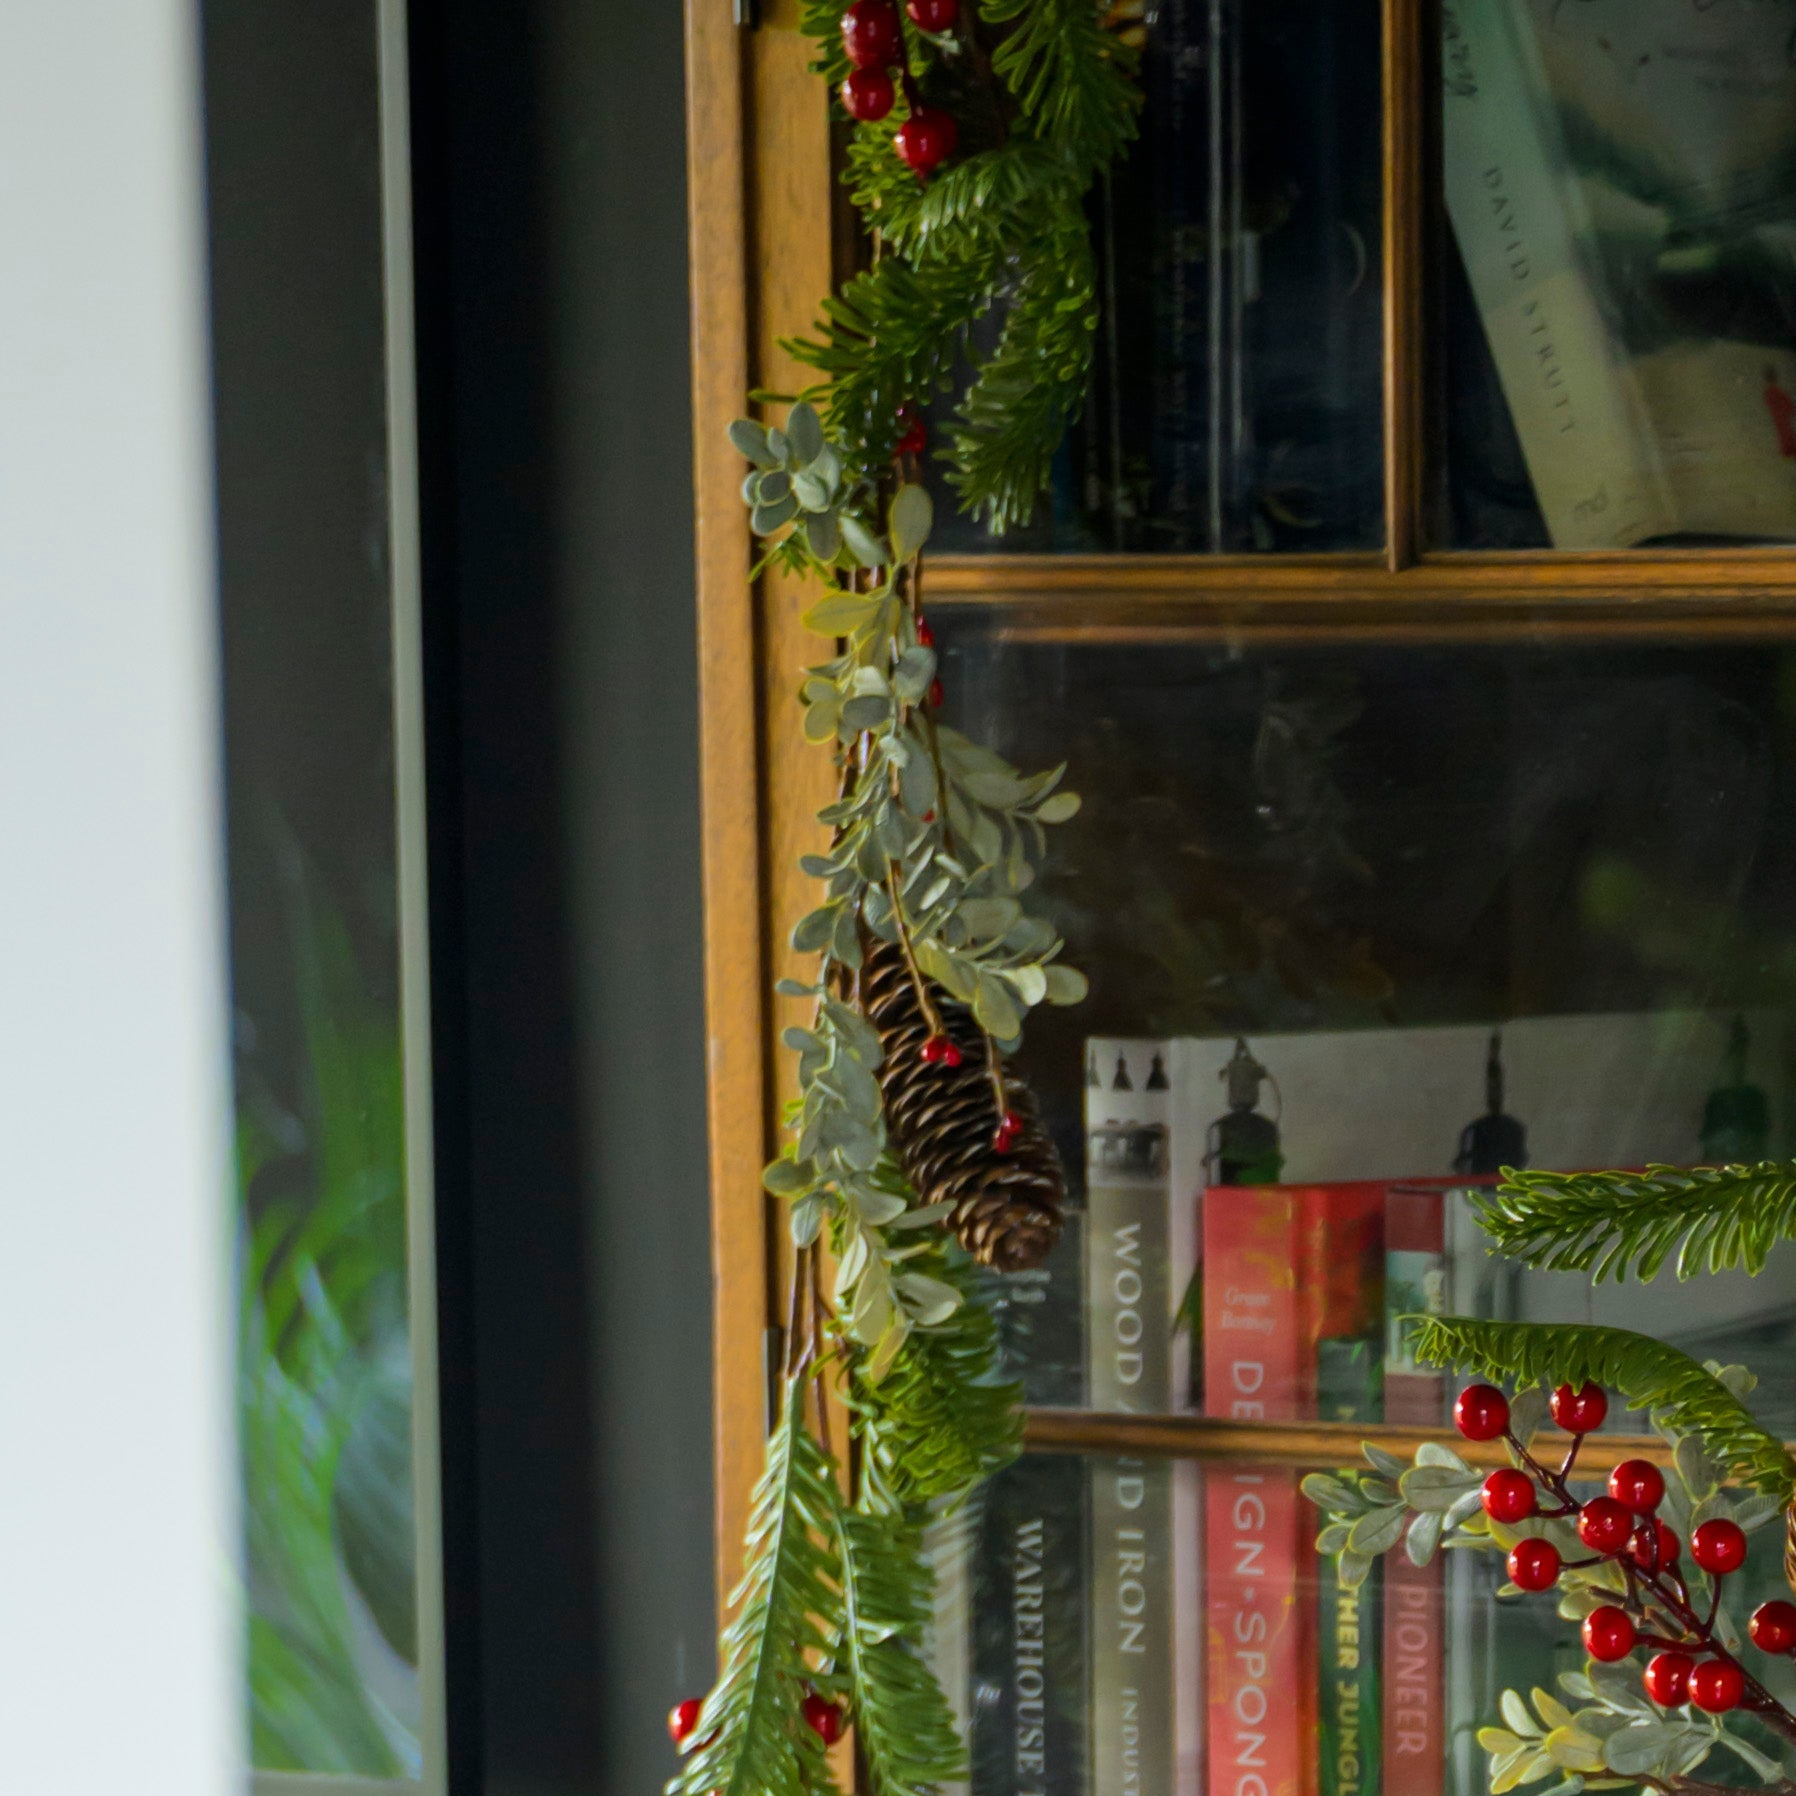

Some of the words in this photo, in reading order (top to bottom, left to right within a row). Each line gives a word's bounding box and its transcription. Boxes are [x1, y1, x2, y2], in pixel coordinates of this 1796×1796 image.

[1480, 166, 1532, 281] DAVID
[1112, 1222, 1144, 1386] WOOD
[1232, 1360, 1266, 1577] DEIGN
[1014, 1518, 1046, 1776] WAREHOUSE
[1115, 1527, 1146, 1655] IRON
[1395, 1585, 1429, 1756] PIONEER
